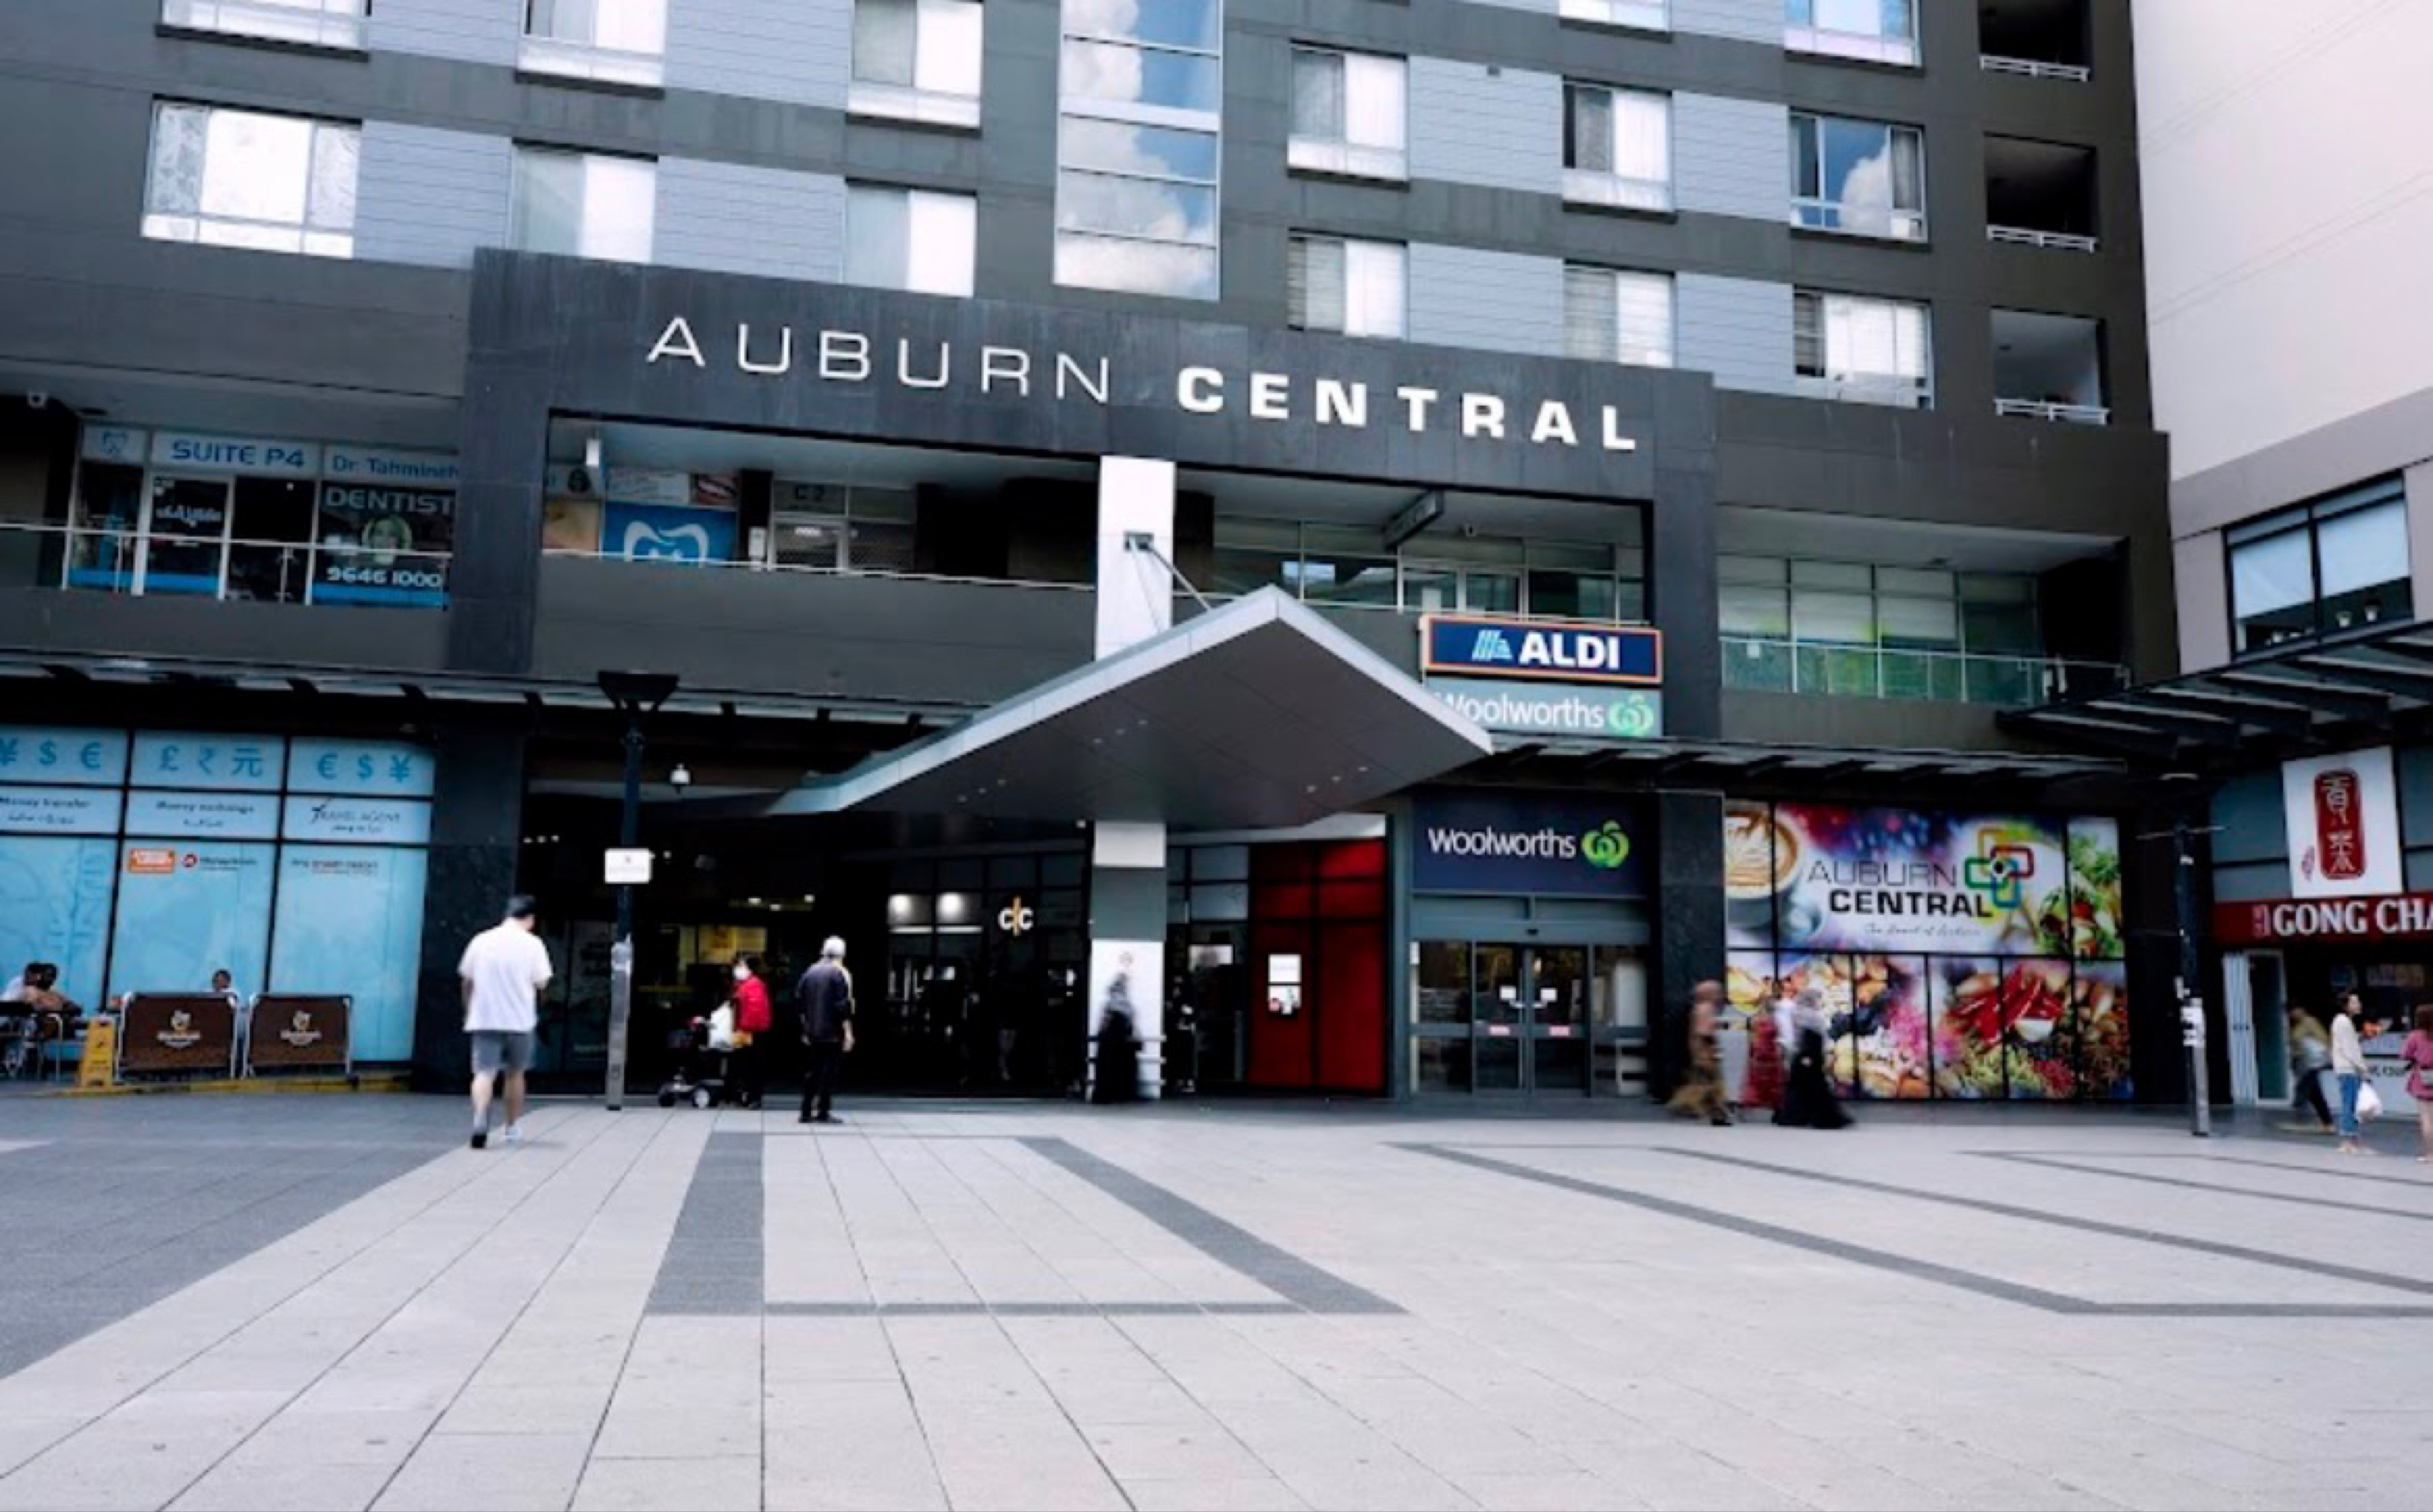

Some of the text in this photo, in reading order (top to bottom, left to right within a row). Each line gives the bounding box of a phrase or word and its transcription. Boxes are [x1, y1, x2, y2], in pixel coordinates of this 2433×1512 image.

[646, 316, 1636, 451] AUBURN CENTRAL
[170, 440, 305, 468] SUITE P4
[326, 486, 455, 515] DENTIST
[326, 566, 443, 588] 9646 1000
[1519, 631, 1621, 669] ALDI
[39, 740, 58, 766] $
[81, 742, 103, 769] €
[160, 745, 180, 771] £
[318, 753, 412, 782] € $ ¥
[1428, 825, 1577, 859] Woolworths
[1807, 860, 1957, 887] AUBURN
[1830, 889, 1996, 918] CENTRAL
[2272, 900, 2370, 937] GONG
